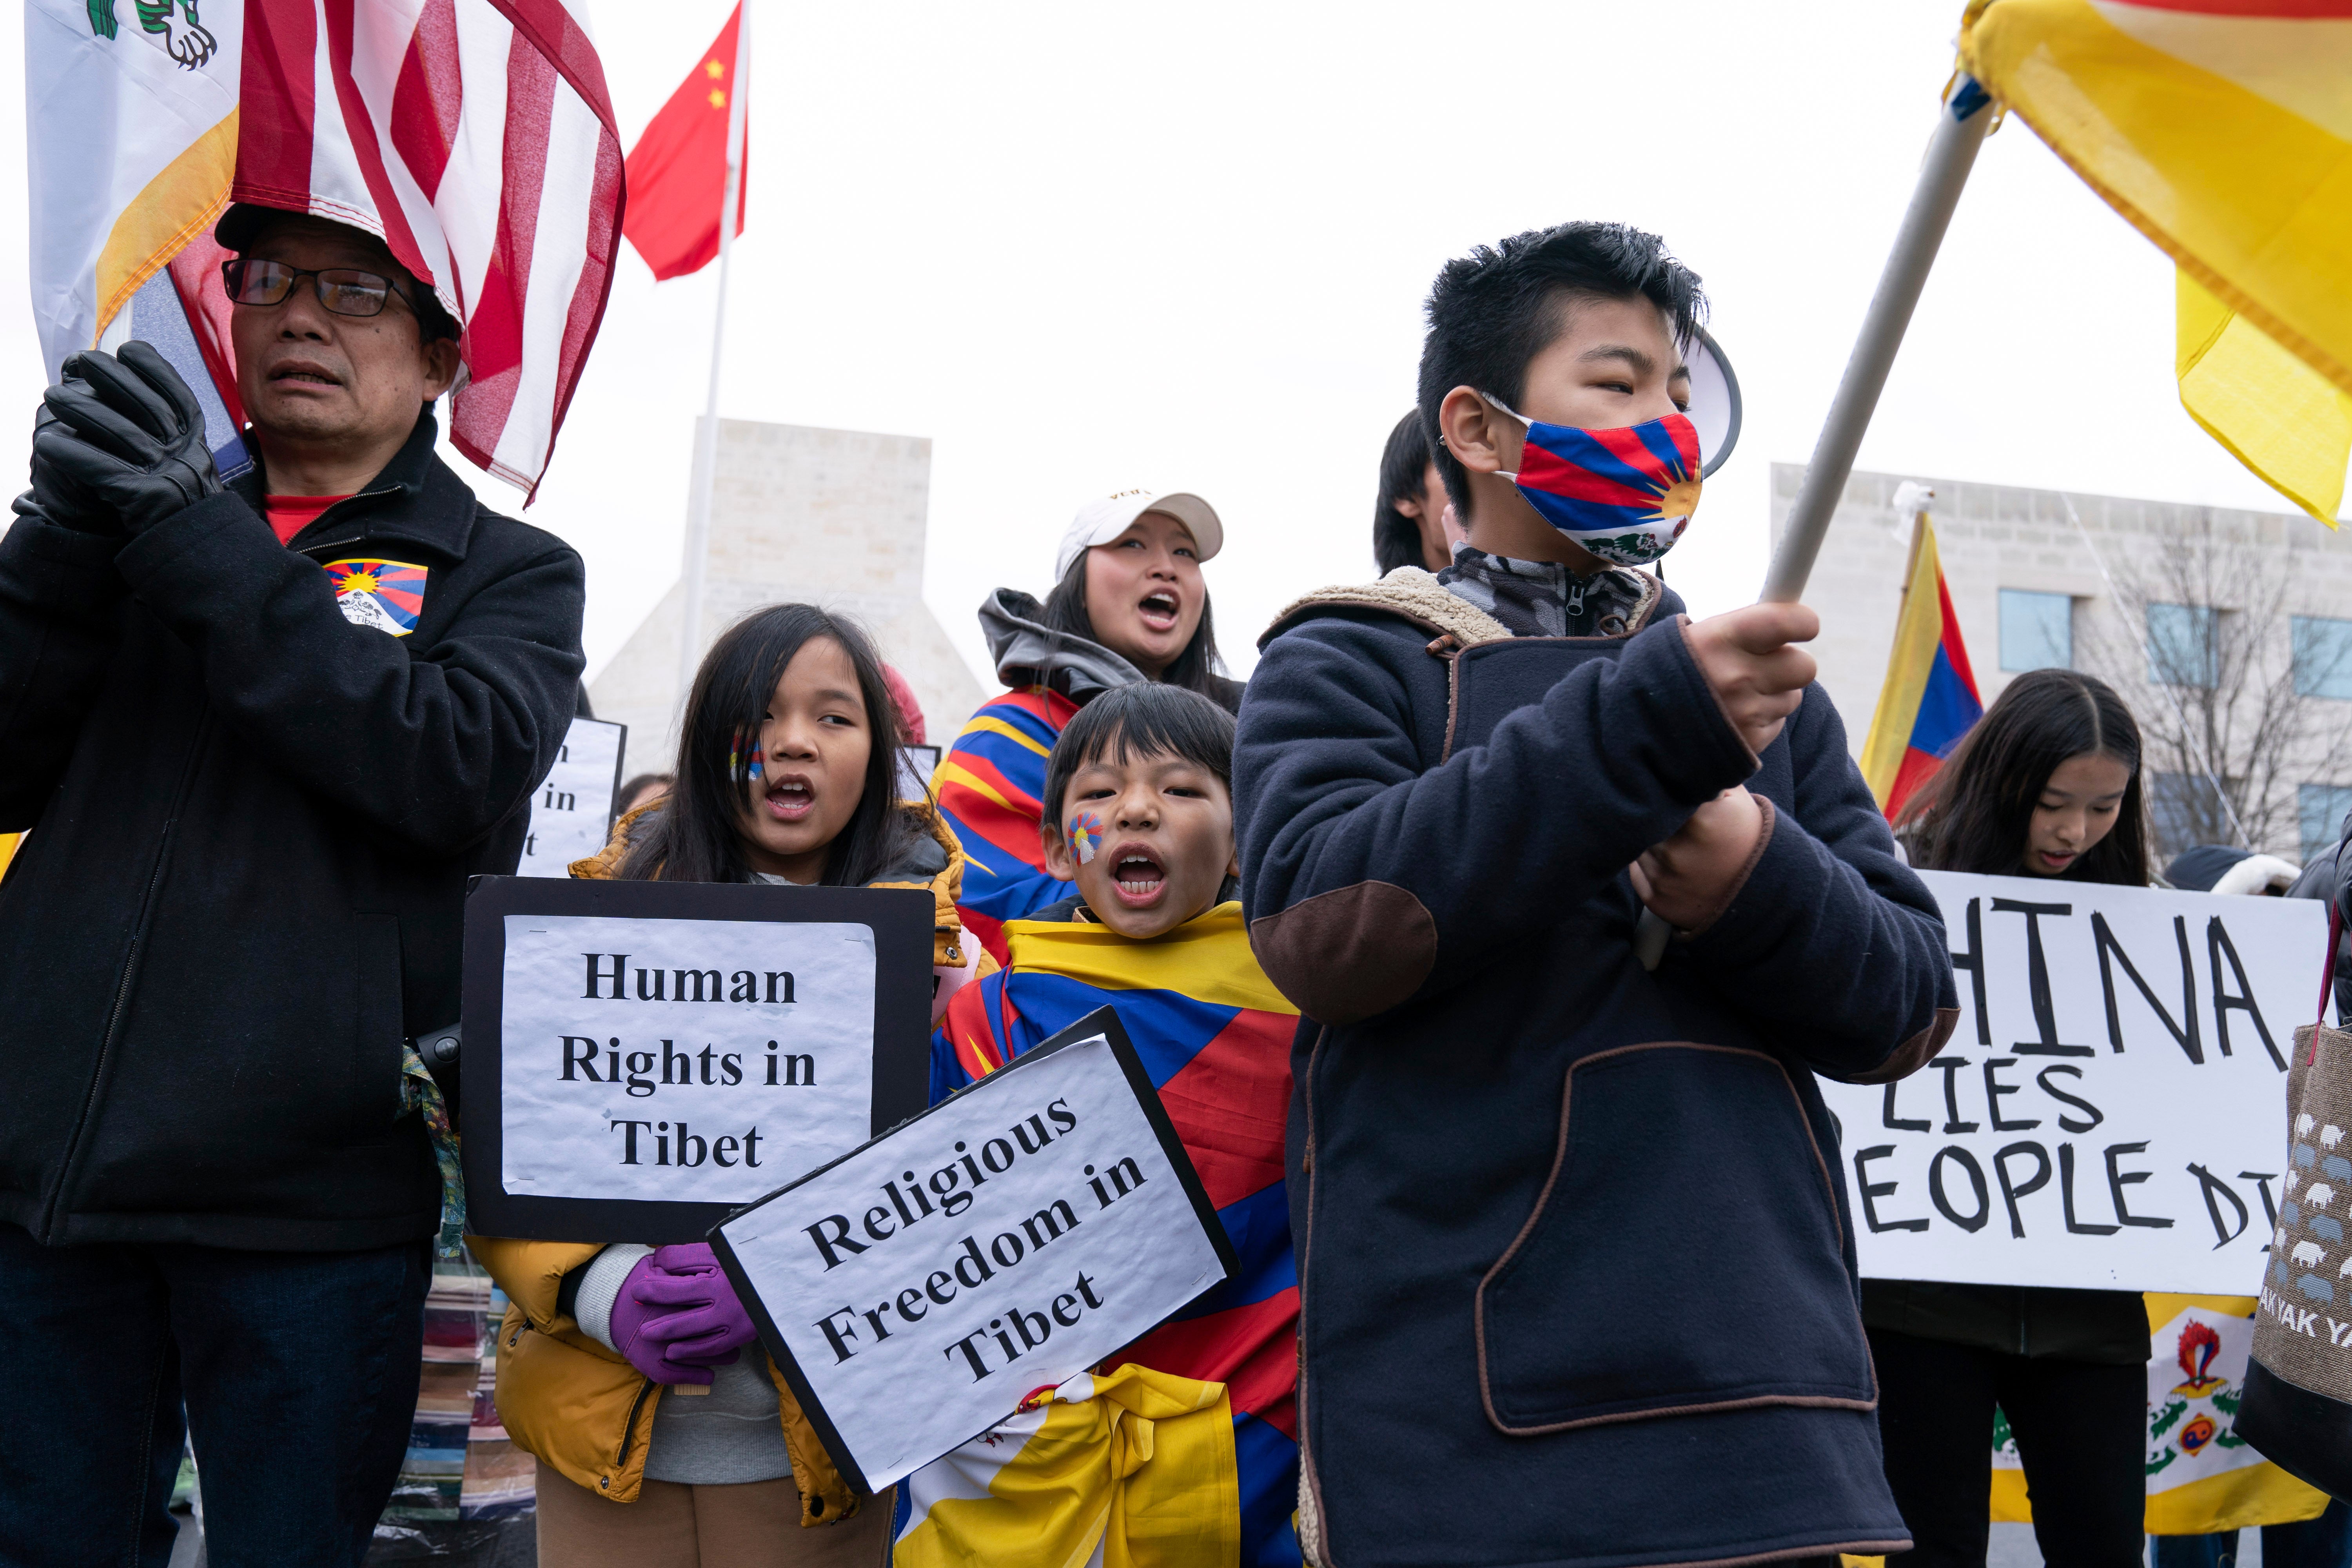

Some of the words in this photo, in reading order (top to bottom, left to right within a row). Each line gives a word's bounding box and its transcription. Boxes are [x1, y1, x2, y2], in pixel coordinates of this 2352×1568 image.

[355, 615, 383, 629] Tibet
[544, 783, 575, 811] in
[580, 953, 798, 1004] Human
[557, 1036, 743, 1098] Rights
[763, 1040, 817, 1086] in
[1882, 1057, 2104, 1134] LIES
[611, 1120, 763, 1168] Tibet
[801, 1097, 1076, 1272] Religious
[1854, 1141, 2175, 1239] EOPLE
[811, 1200, 1082, 1366] Freedom
[1084, 1157, 1148, 1210] in
[944, 1270, 1104, 1384] Tibet
[2278, 1296, 2318, 1338] YAK
